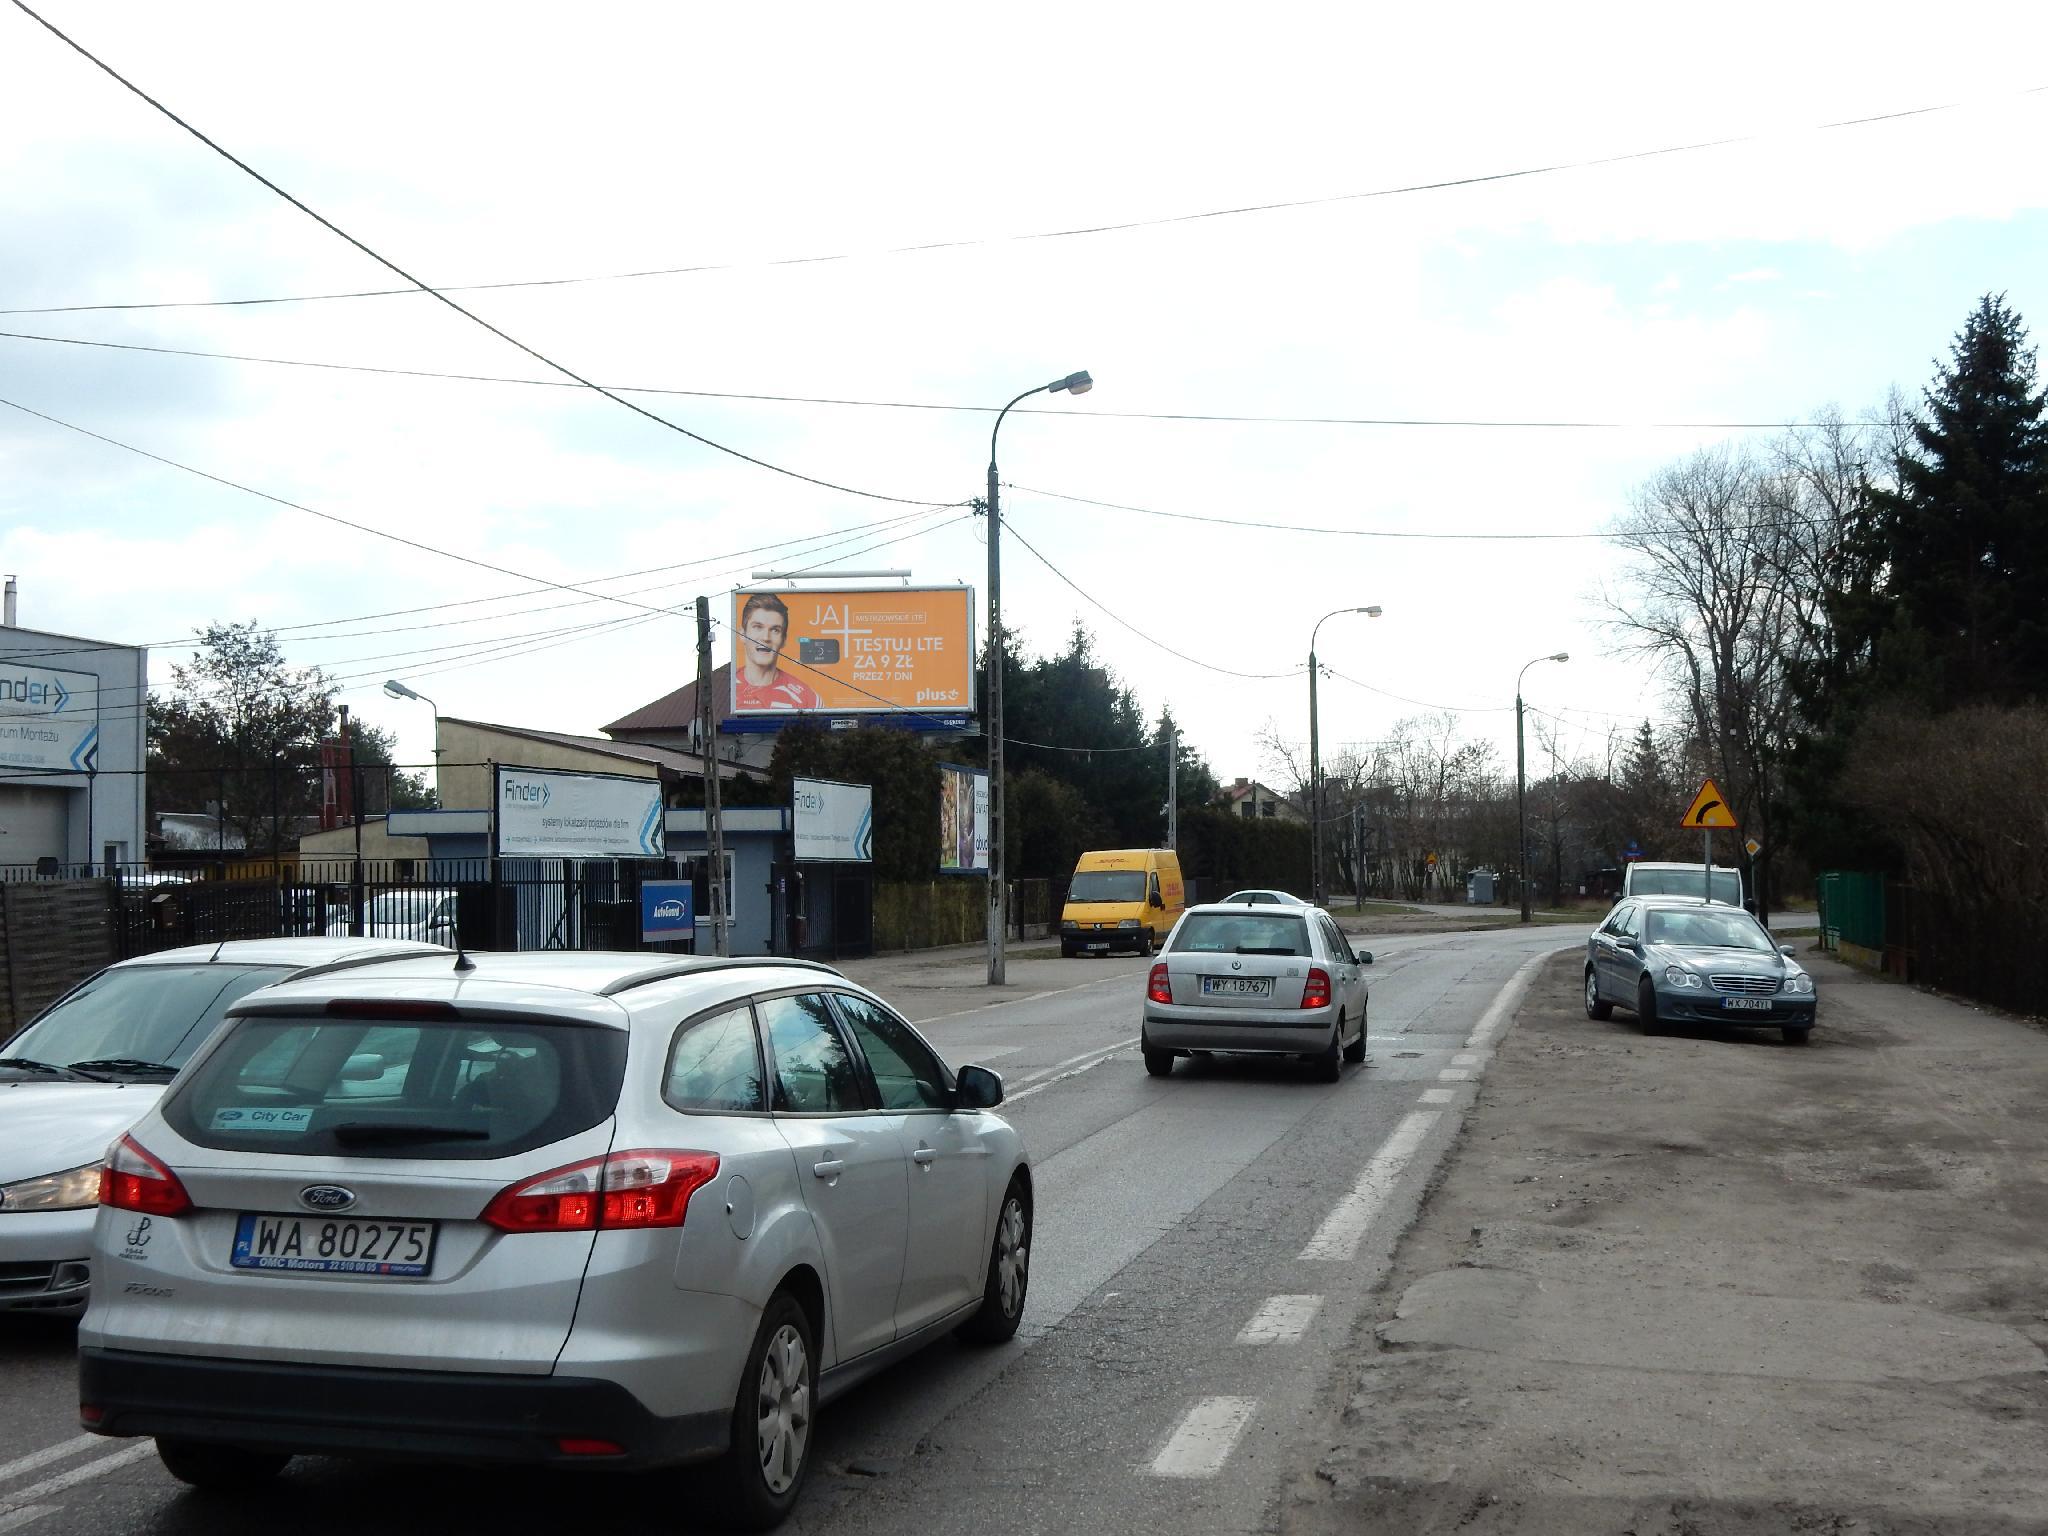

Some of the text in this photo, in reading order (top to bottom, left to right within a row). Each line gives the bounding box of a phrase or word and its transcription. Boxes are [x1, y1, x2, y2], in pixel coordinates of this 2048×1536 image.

[809, 604, 840, 626] JA
[853, 637, 944, 652] TESTUJ LTE
[854, 654, 914, 669] ZA 9 ZŁ
[853, 671, 912, 681] PRZEZ 7 DNI
[916, 687, 946, 704] plus
[20, 727, 59, 743] Montażu
[505, 779, 540, 802] Finder
[1212, 978, 1229, 991] WY
[1233, 980, 1267, 993] 18767
[1727, 998, 1741, 1008] WX
[251, 1110, 278, 1122] City
[281, 1110, 308, 1122] Car
[309, 1188, 341, 1205] Ford
[257, 1220, 427, 1262] WA 80275
[258, 1258, 285, 1268] OMC
[287, 1259, 325, 1270] Motors
